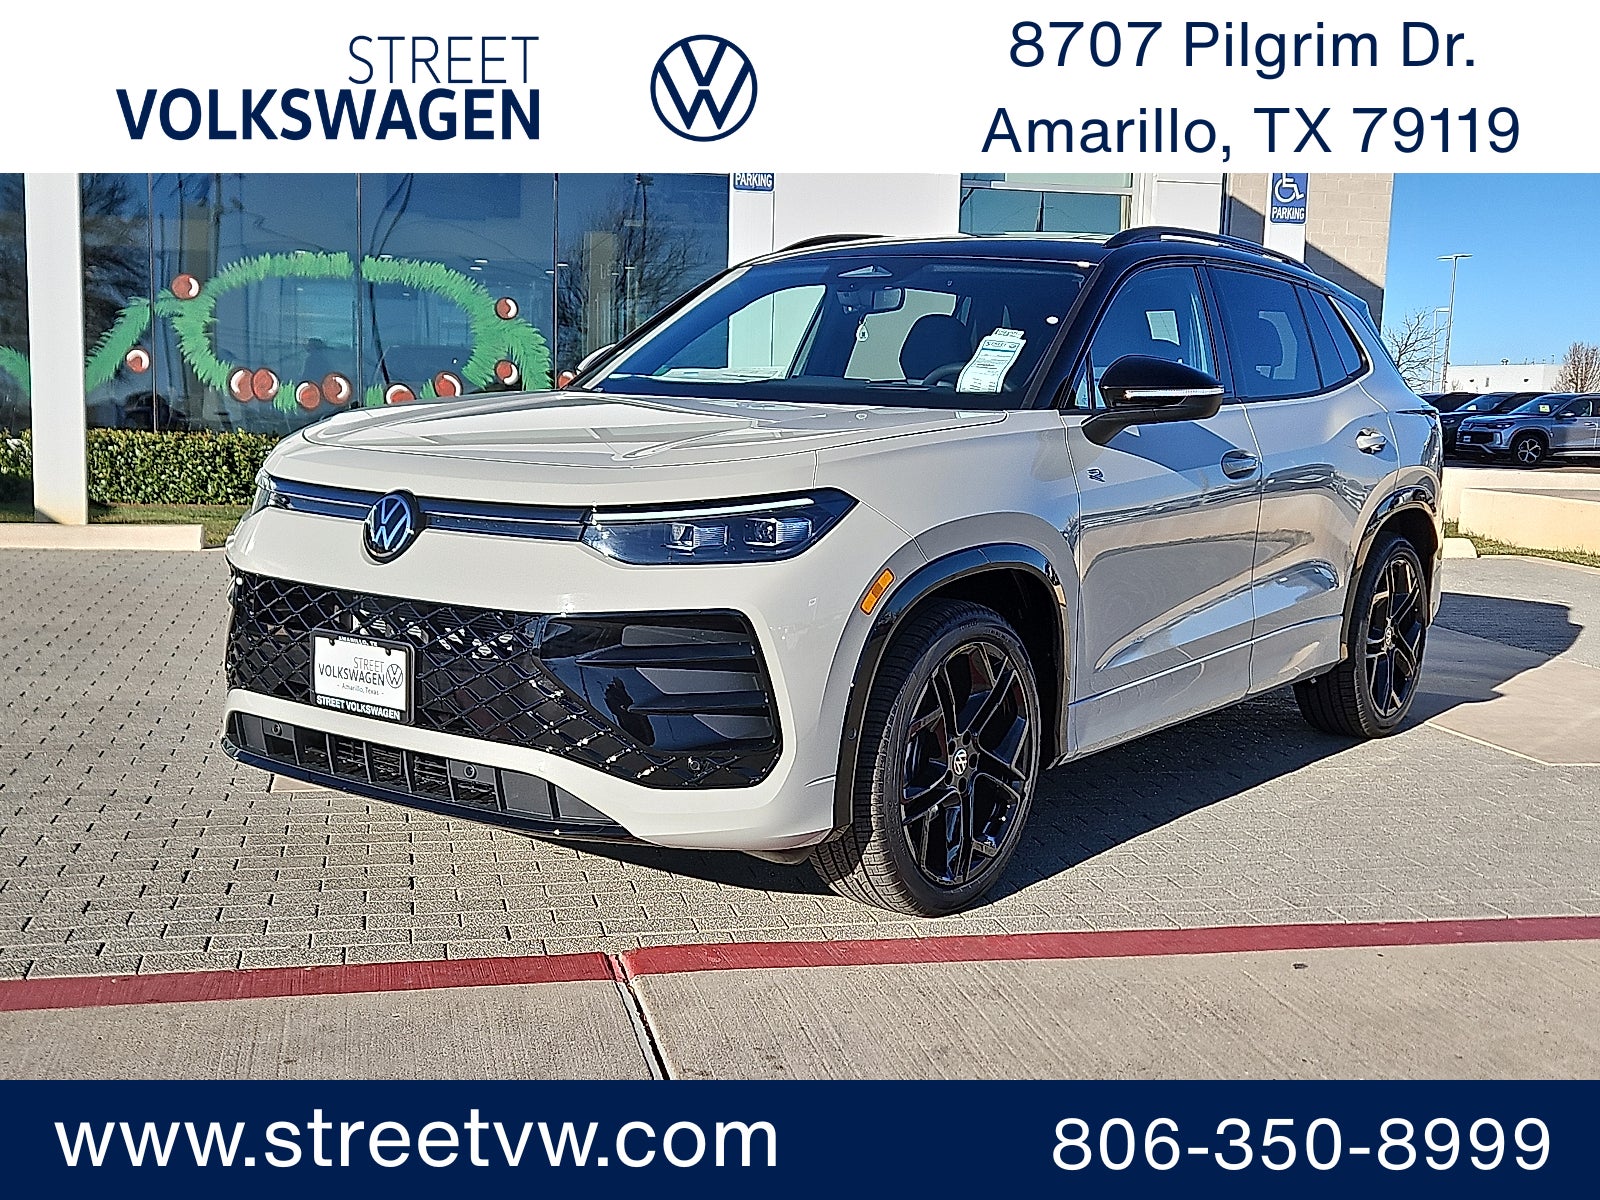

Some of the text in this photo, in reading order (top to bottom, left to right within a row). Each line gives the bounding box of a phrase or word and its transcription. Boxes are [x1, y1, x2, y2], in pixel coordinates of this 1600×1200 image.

[735, 173, 773, 188] PARKING
[1271, 206, 1305, 220] PARKING
[353, 656, 385, 673] STREET
[318, 662, 385, 687] VOLKSWAGEN
[316, 694, 401, 721] STREET VOLKSWAGEN
